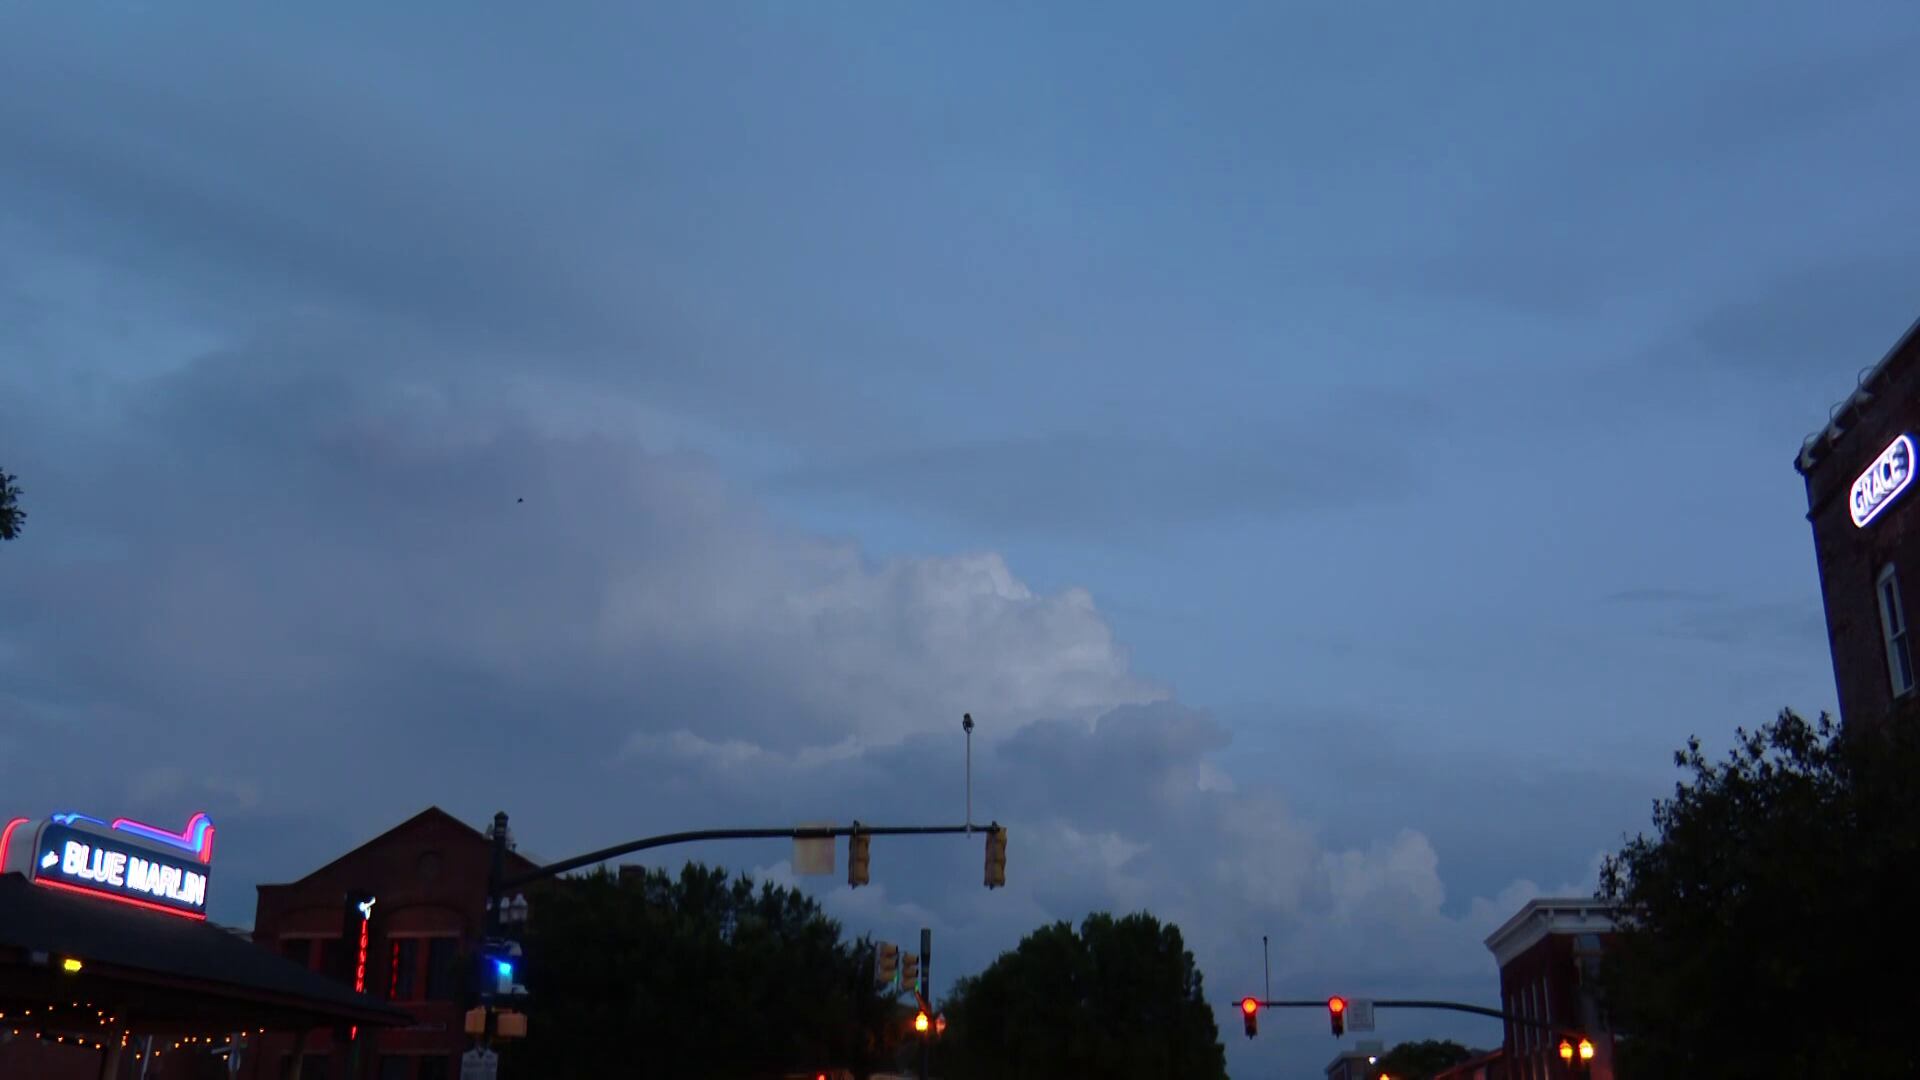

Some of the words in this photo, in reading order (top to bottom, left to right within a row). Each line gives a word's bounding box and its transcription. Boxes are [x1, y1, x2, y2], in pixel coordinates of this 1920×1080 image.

[1854, 444, 1905, 516] GRACE
[62, 840, 127, 887] BLUE
[126, 856, 207, 906] MARLIN
